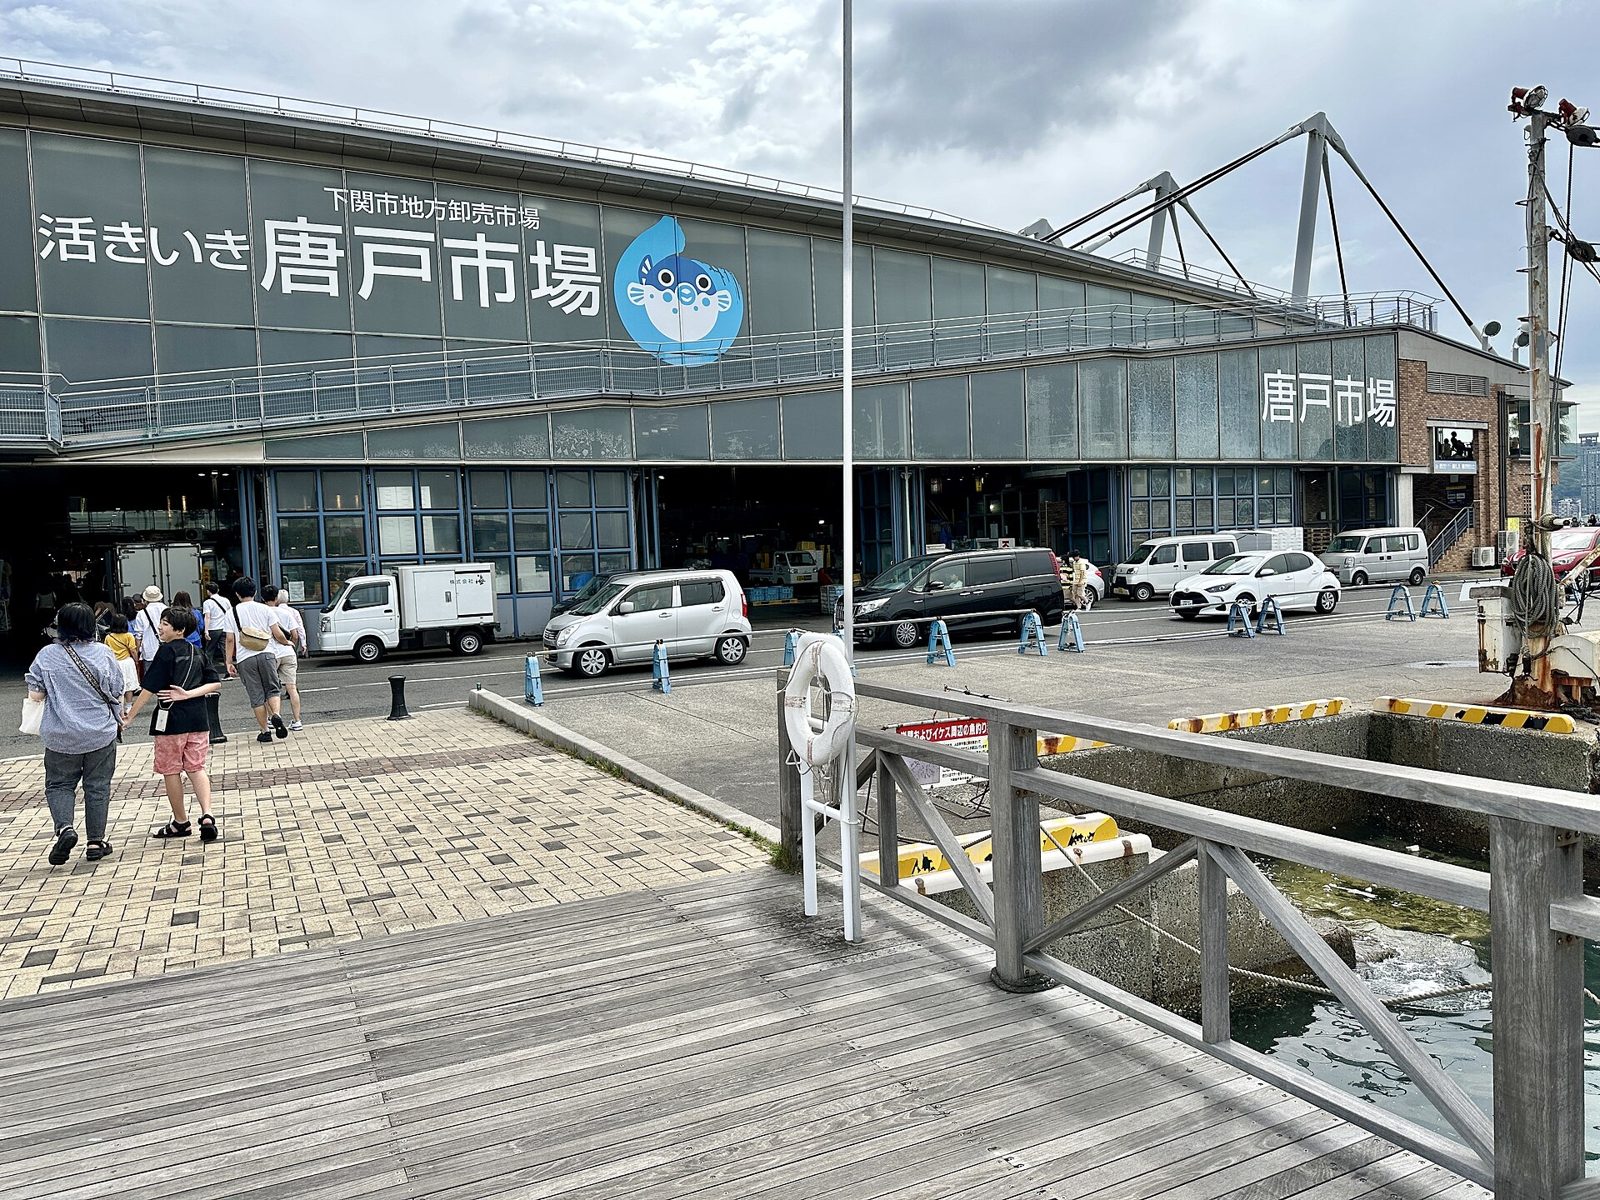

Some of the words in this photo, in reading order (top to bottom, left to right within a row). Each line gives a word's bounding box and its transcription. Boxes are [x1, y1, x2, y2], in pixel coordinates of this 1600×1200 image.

[323, 186, 541, 231] 下関市地方卸売市場
[260, 216, 602, 317] 唐戸市場
[1261, 369, 1397, 428] 唐戸市場
